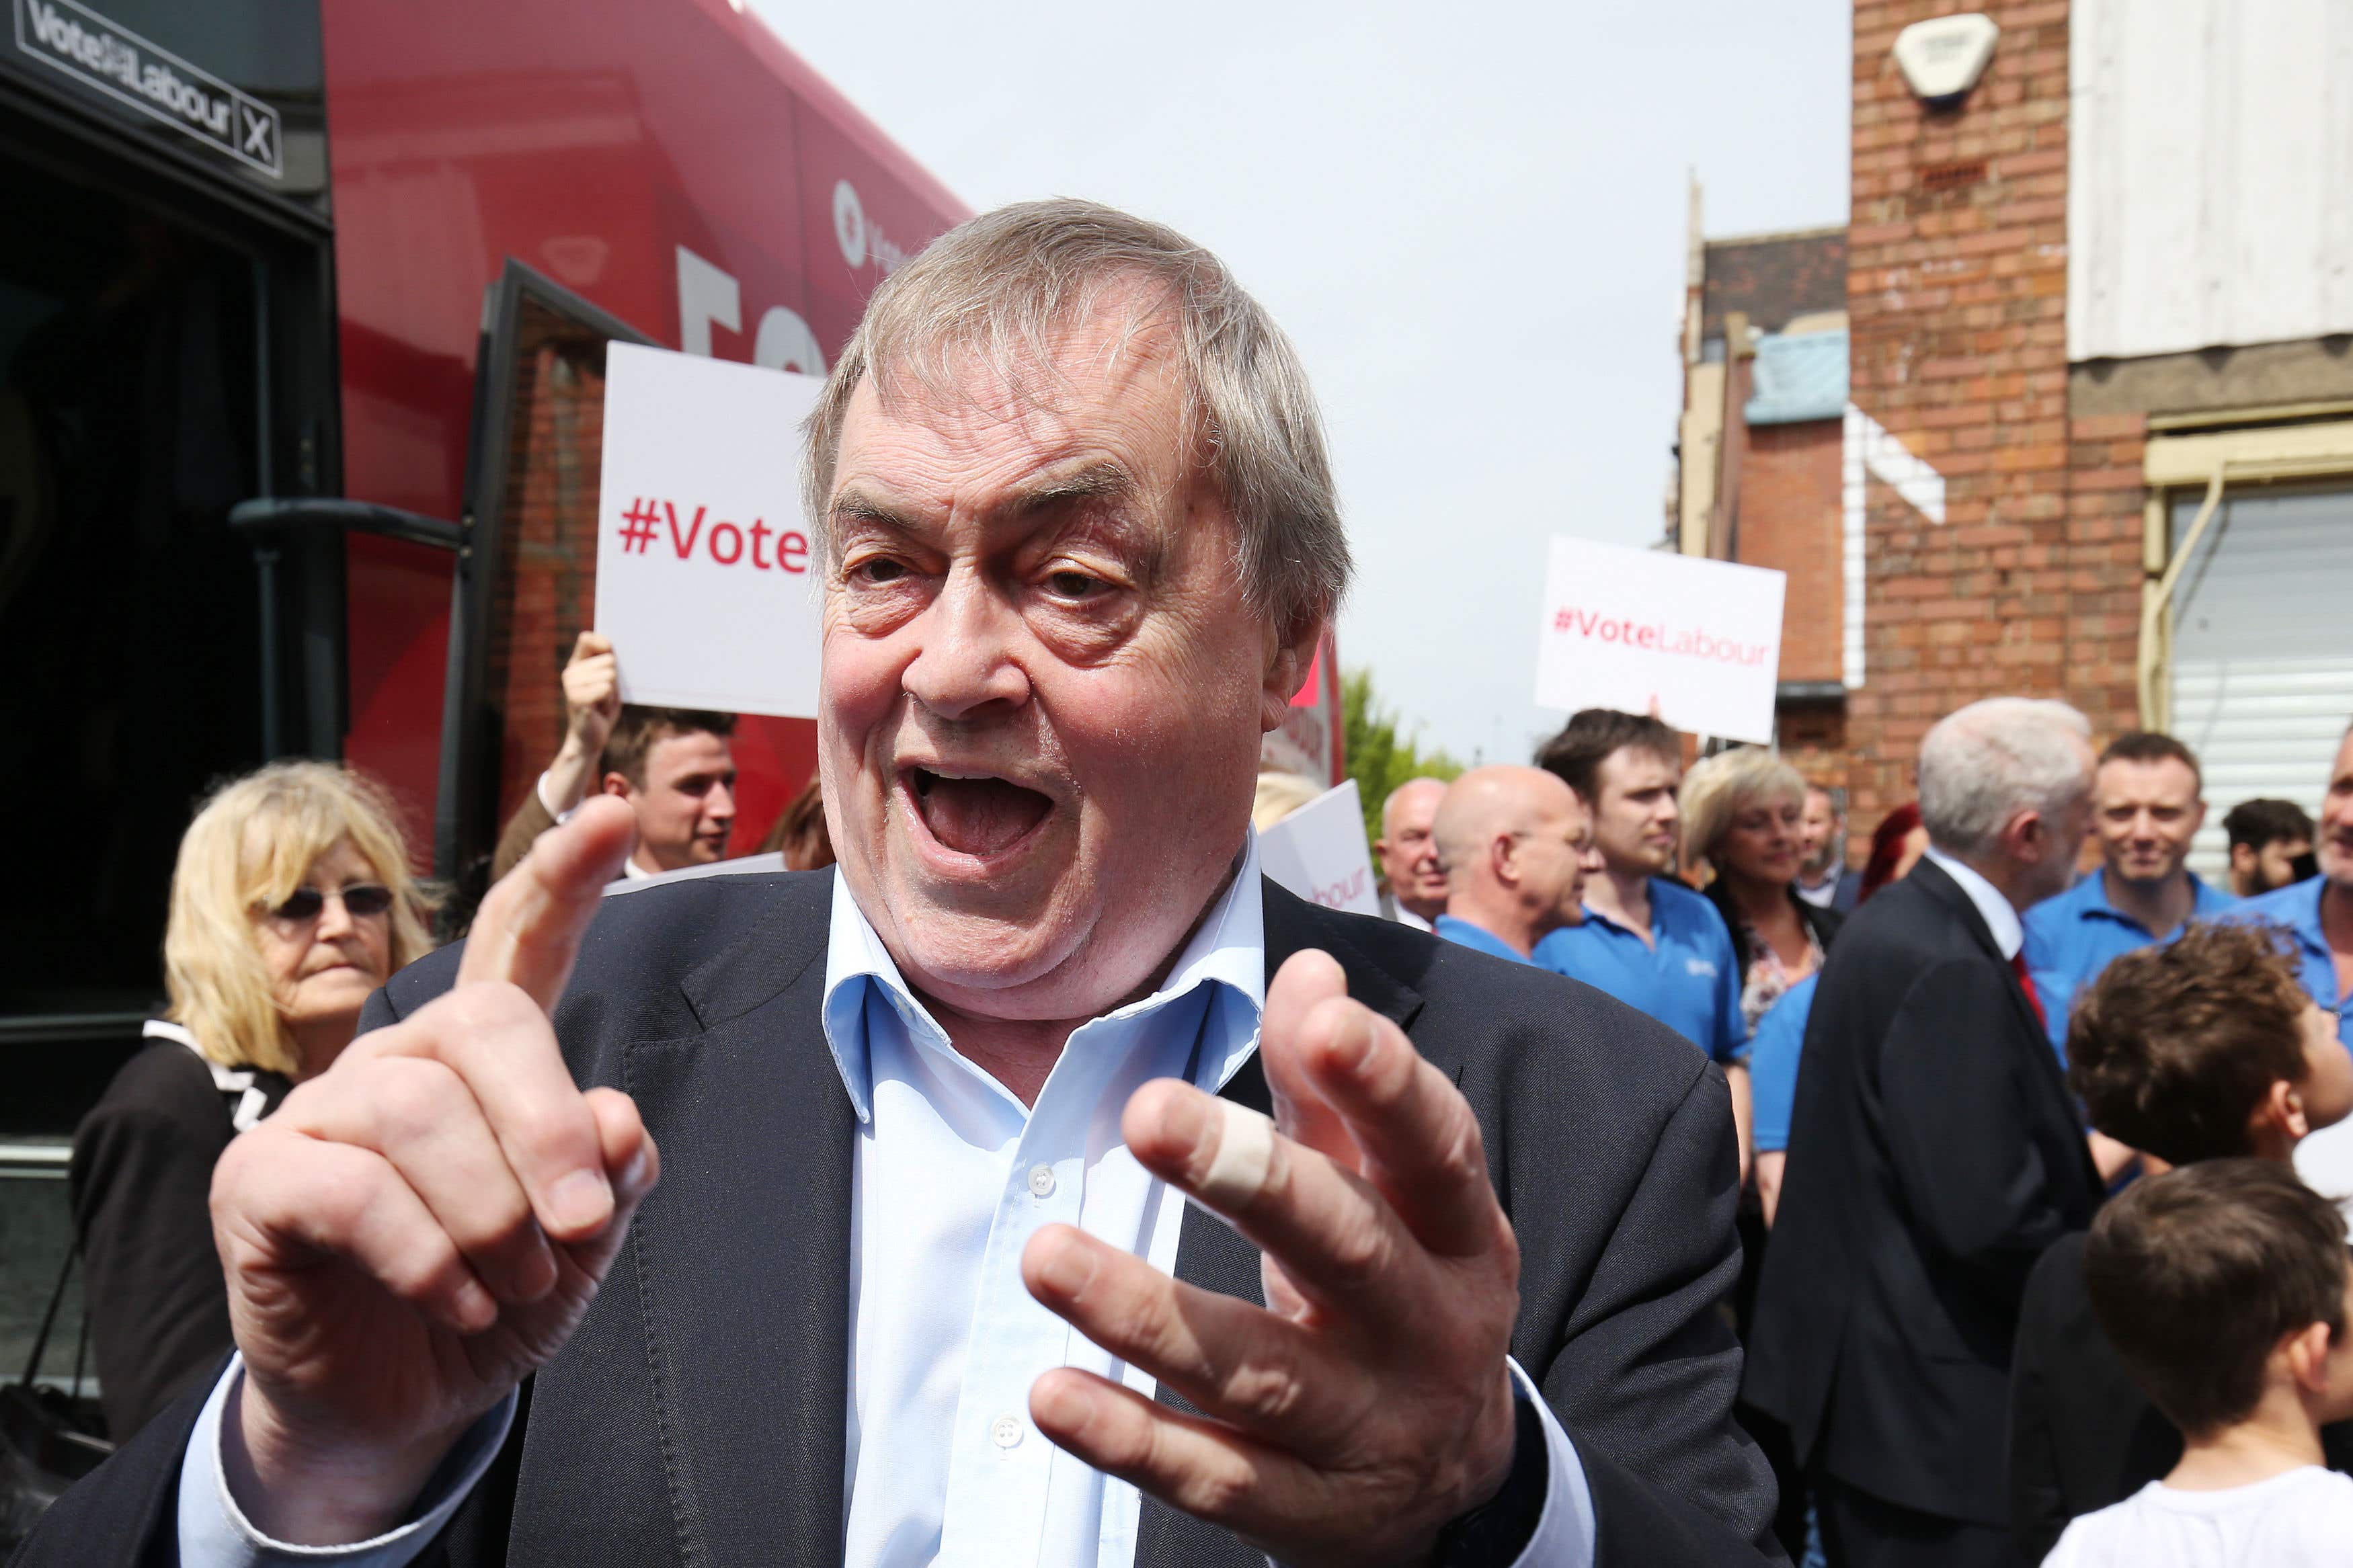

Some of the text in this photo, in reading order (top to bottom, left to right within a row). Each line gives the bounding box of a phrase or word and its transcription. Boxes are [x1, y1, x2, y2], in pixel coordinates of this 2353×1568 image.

[28, 0, 104, 68] Vote
[126, 48, 232, 134] Labour
[618, 495, 807, 574] #Vote
[1553, 606, 1770, 666] #VoteLabour
[1309, 867, 1365, 909] bour
